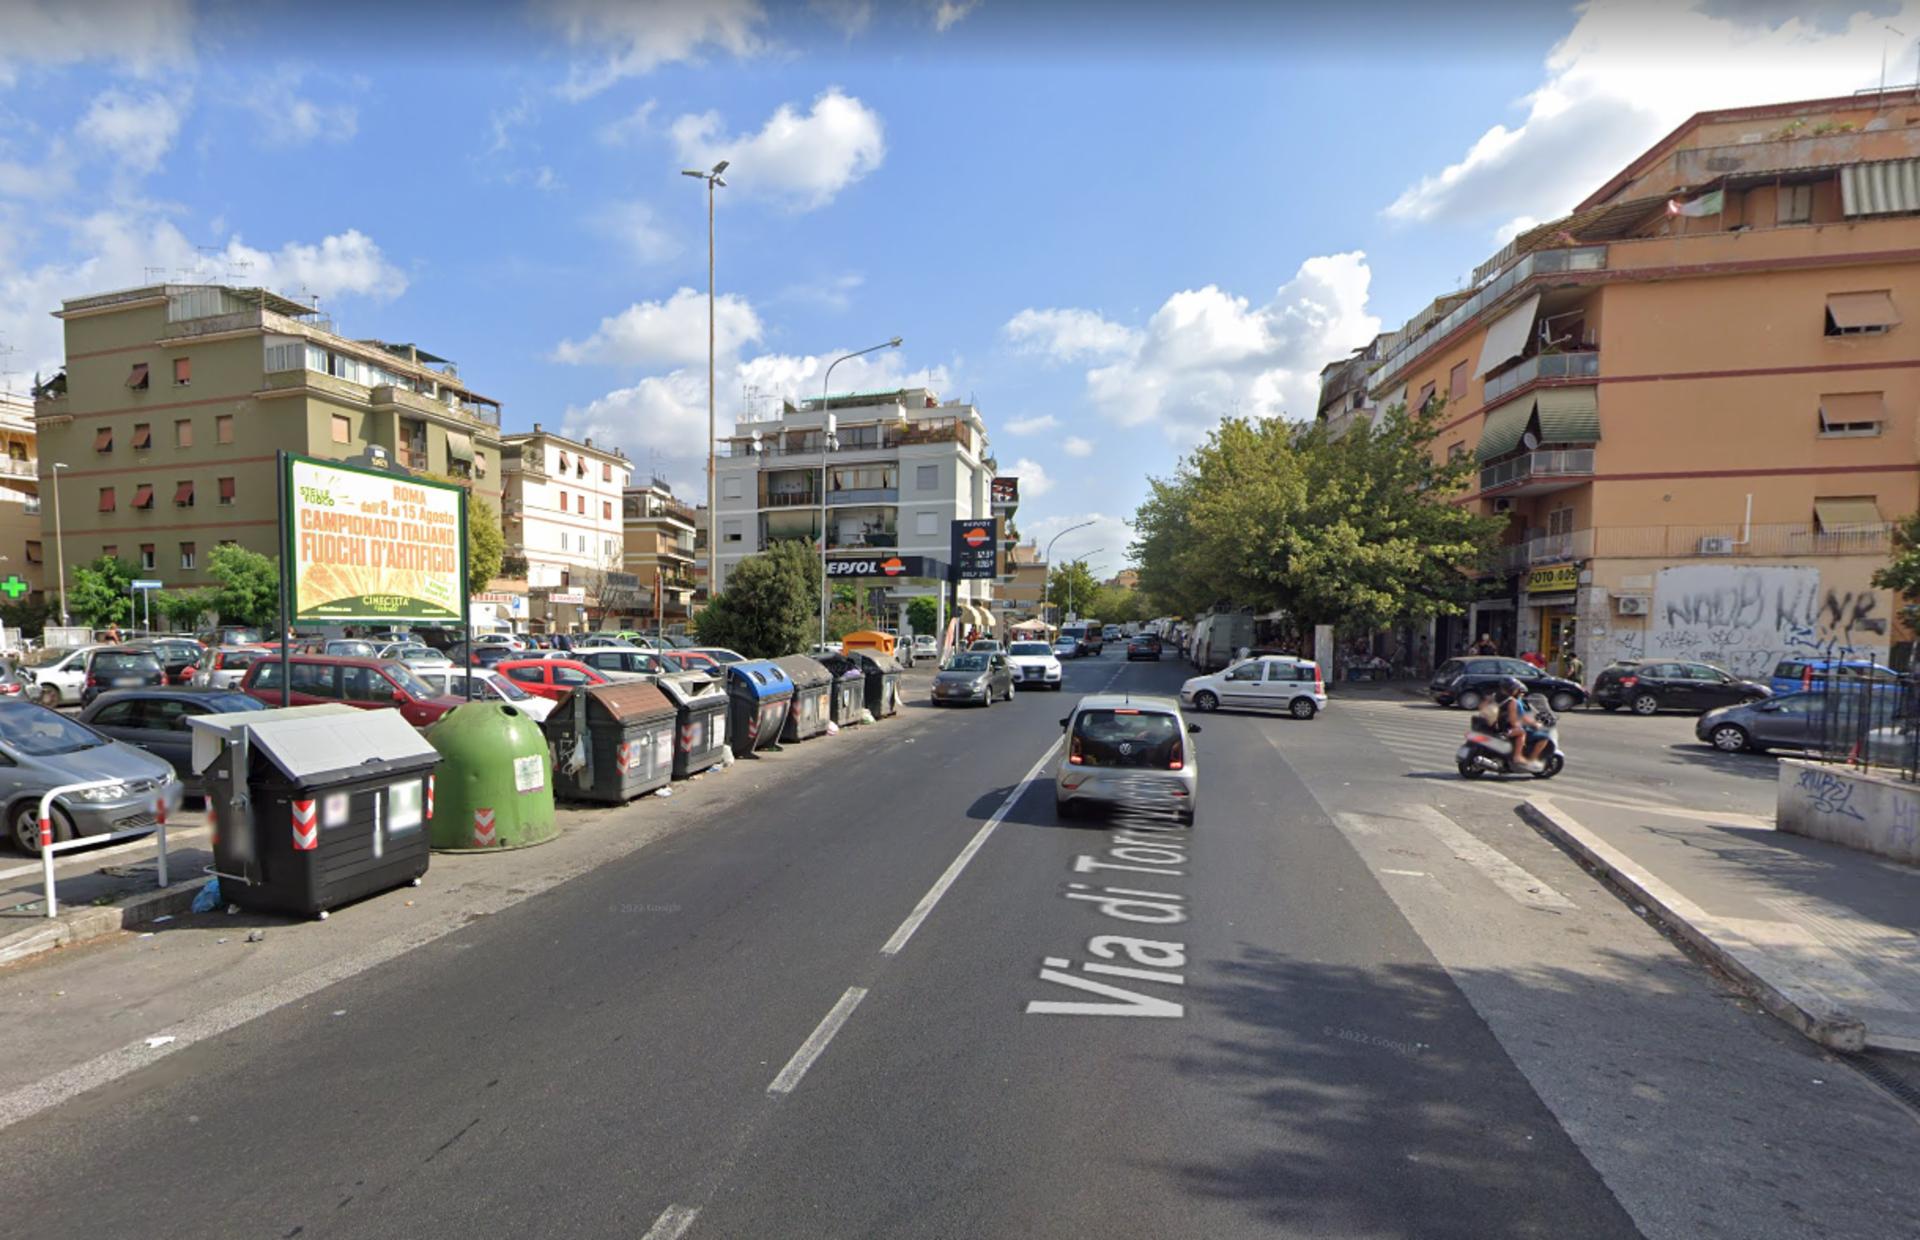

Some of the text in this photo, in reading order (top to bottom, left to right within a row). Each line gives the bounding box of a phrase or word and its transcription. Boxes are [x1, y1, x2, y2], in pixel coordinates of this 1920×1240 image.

[393, 485, 427, 506] ROMA
[402, 504, 416, 520] 15
[419, 507, 455, 526] Agosto
[301, 508, 455, 546] CAMPIONATO ITALIANO
[301, 531, 456, 574] FUOCHI D'ARTIFICIO
[826, 561, 877, 575] EPSOL
